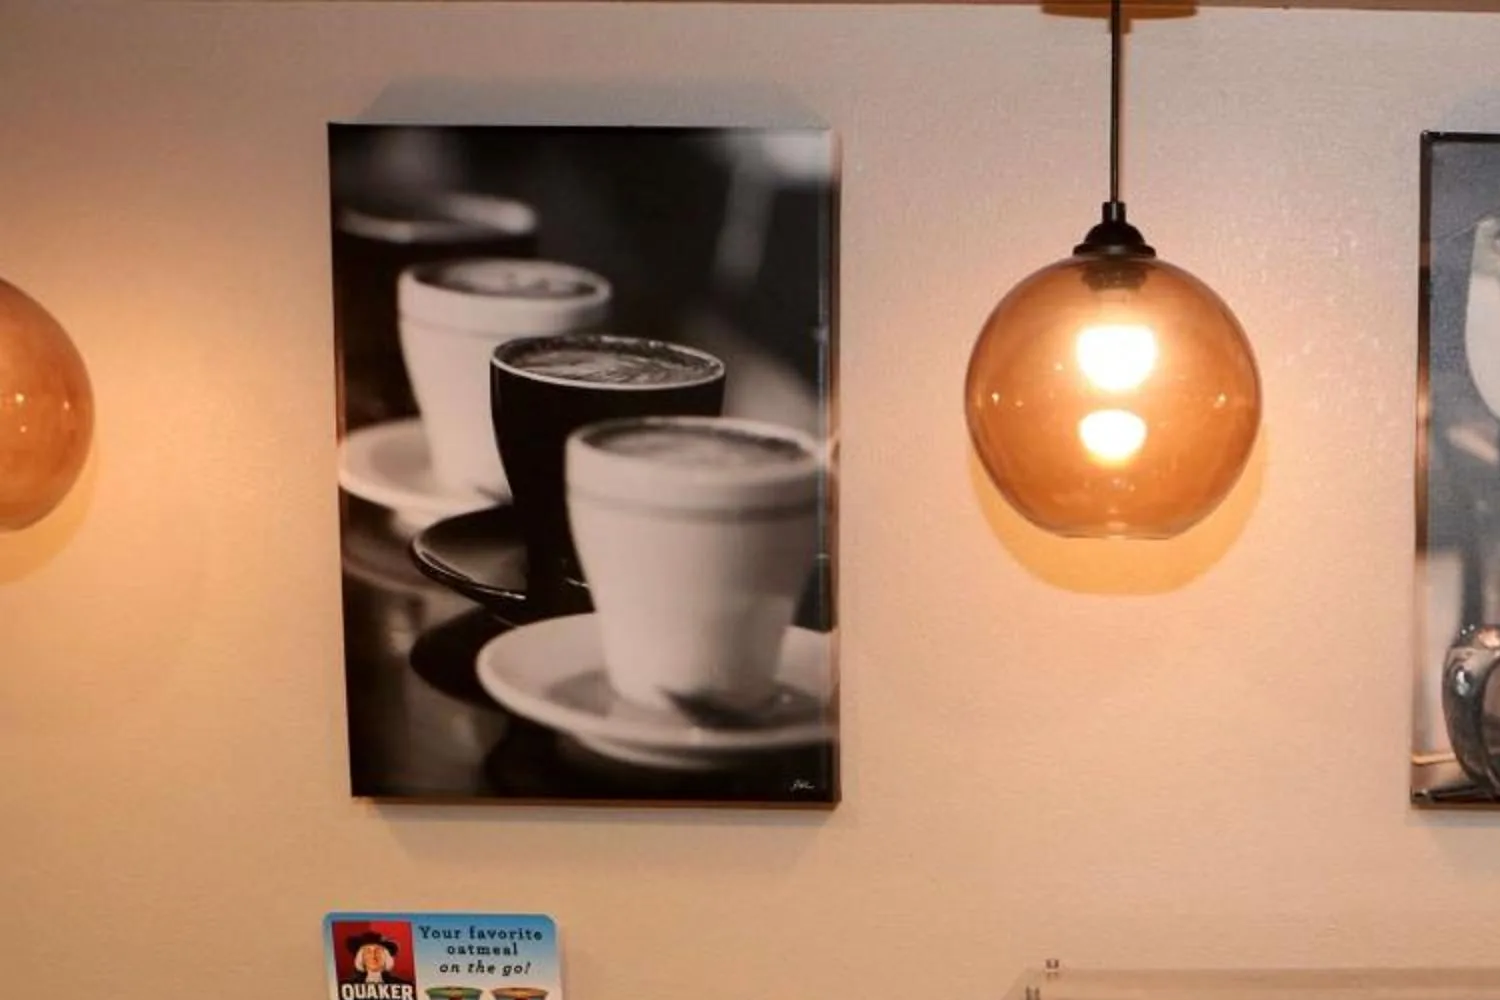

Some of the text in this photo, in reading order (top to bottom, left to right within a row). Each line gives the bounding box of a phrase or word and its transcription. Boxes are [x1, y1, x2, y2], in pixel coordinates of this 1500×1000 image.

[419, 926, 543, 940] Your favorite
[447, 942, 518, 956] oatmeal
[439, 960, 532, 977] on the go!
